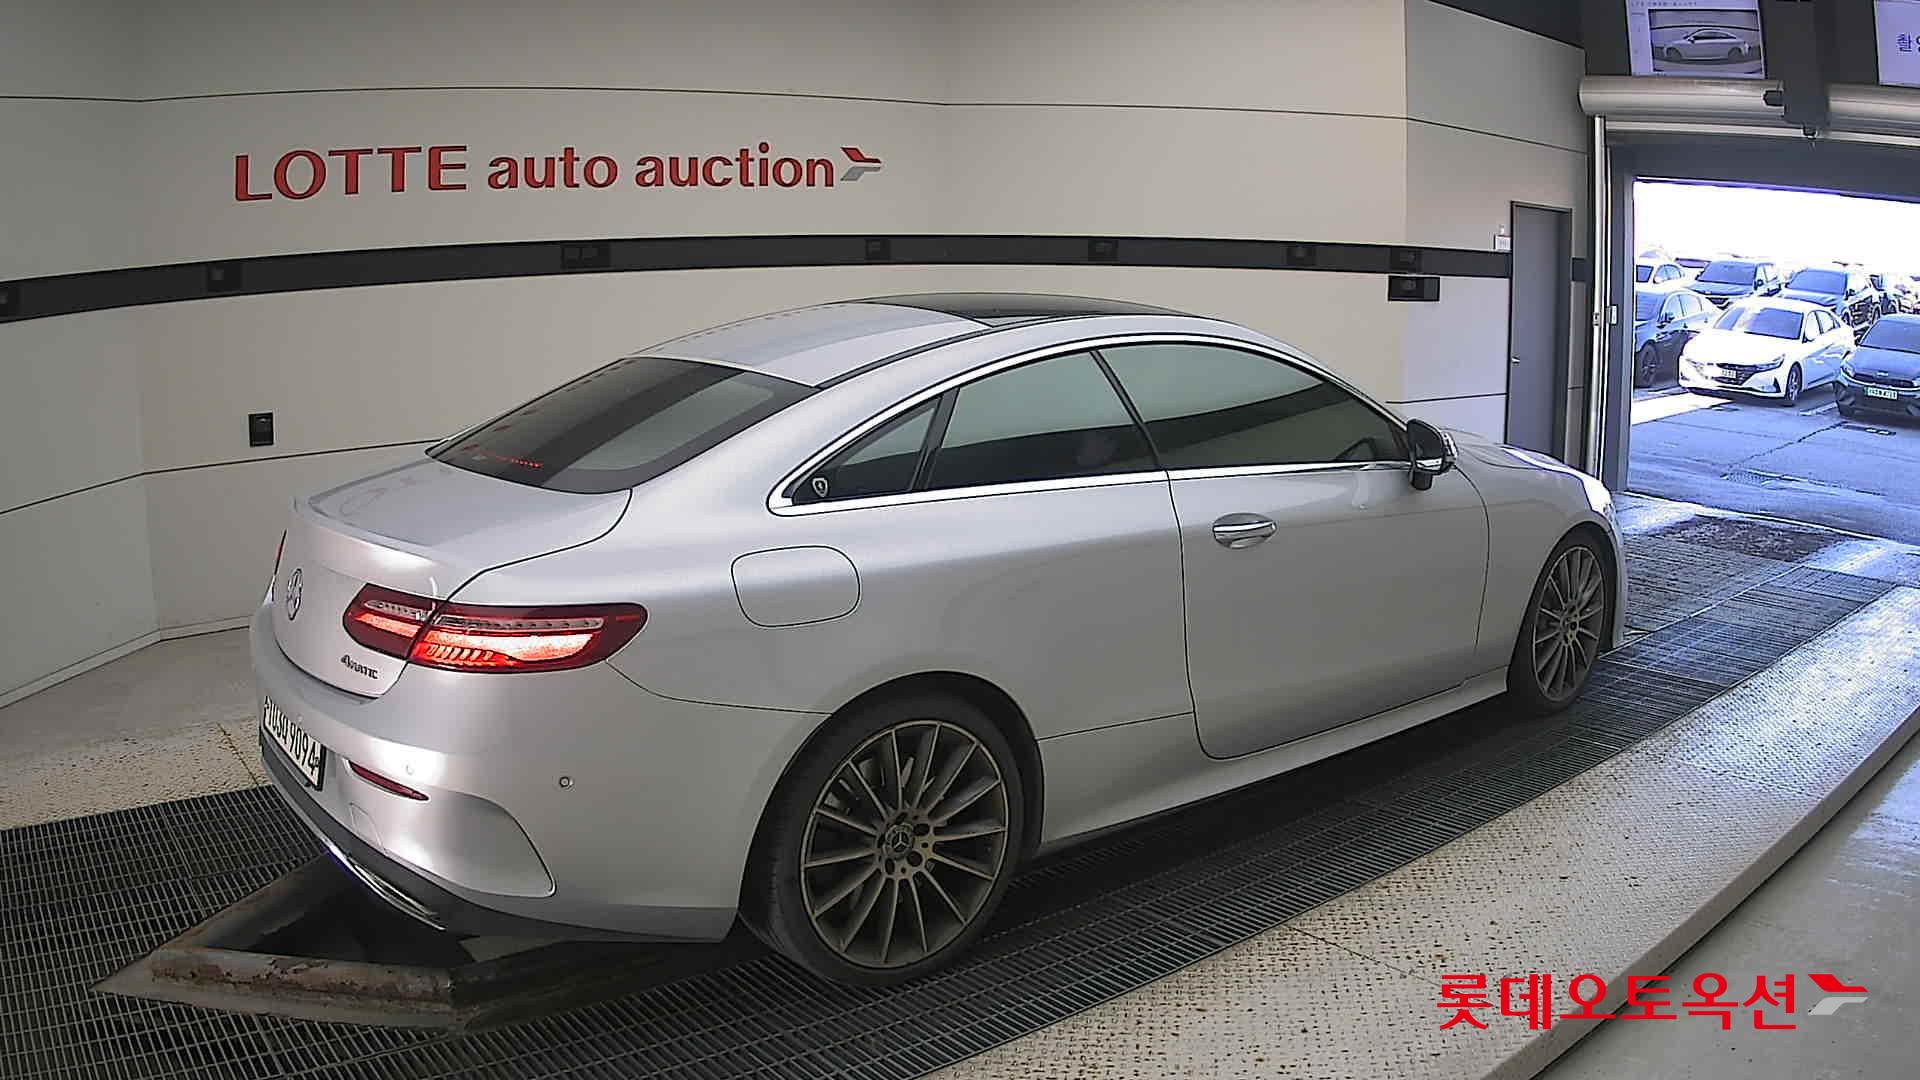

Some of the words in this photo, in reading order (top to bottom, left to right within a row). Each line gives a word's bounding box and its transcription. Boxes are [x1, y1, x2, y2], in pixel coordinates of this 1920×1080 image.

[1896, 31, 1920, 53] 촬
[235, 146, 468, 201] LOTTE
[489, 147, 617, 189] auto
[637, 141, 834, 188] auction
